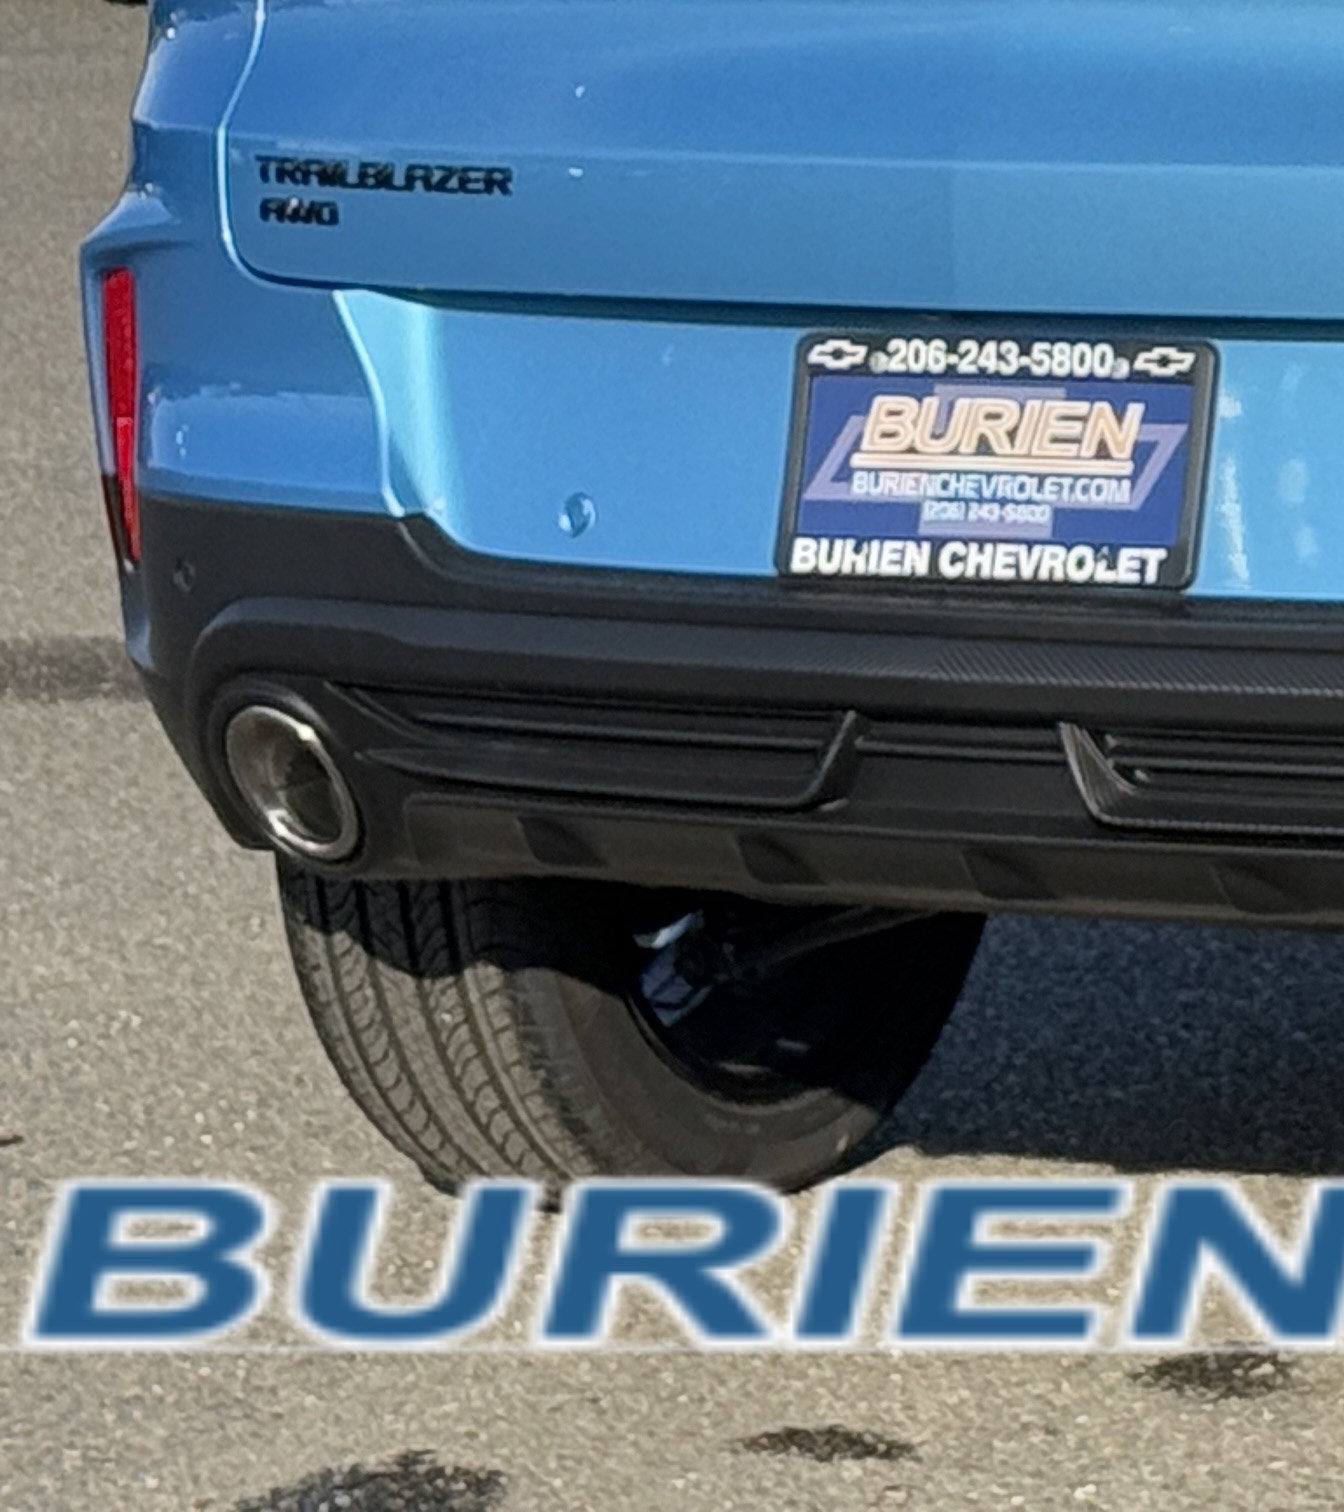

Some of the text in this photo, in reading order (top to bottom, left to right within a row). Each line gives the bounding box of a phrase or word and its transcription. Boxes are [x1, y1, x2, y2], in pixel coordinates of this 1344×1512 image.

[255, 154, 513, 196] TRAILBLAZER
[259, 197, 339, 226] AWD
[887, 339, 1116, 378] 206-243-5800
[860, 395, 1145, 460] BURIEN
[851, 471, 1131, 504] BURIENCHEVROLET.COM
[790, 538, 1168, 585] BURIEN CHEVROLET
